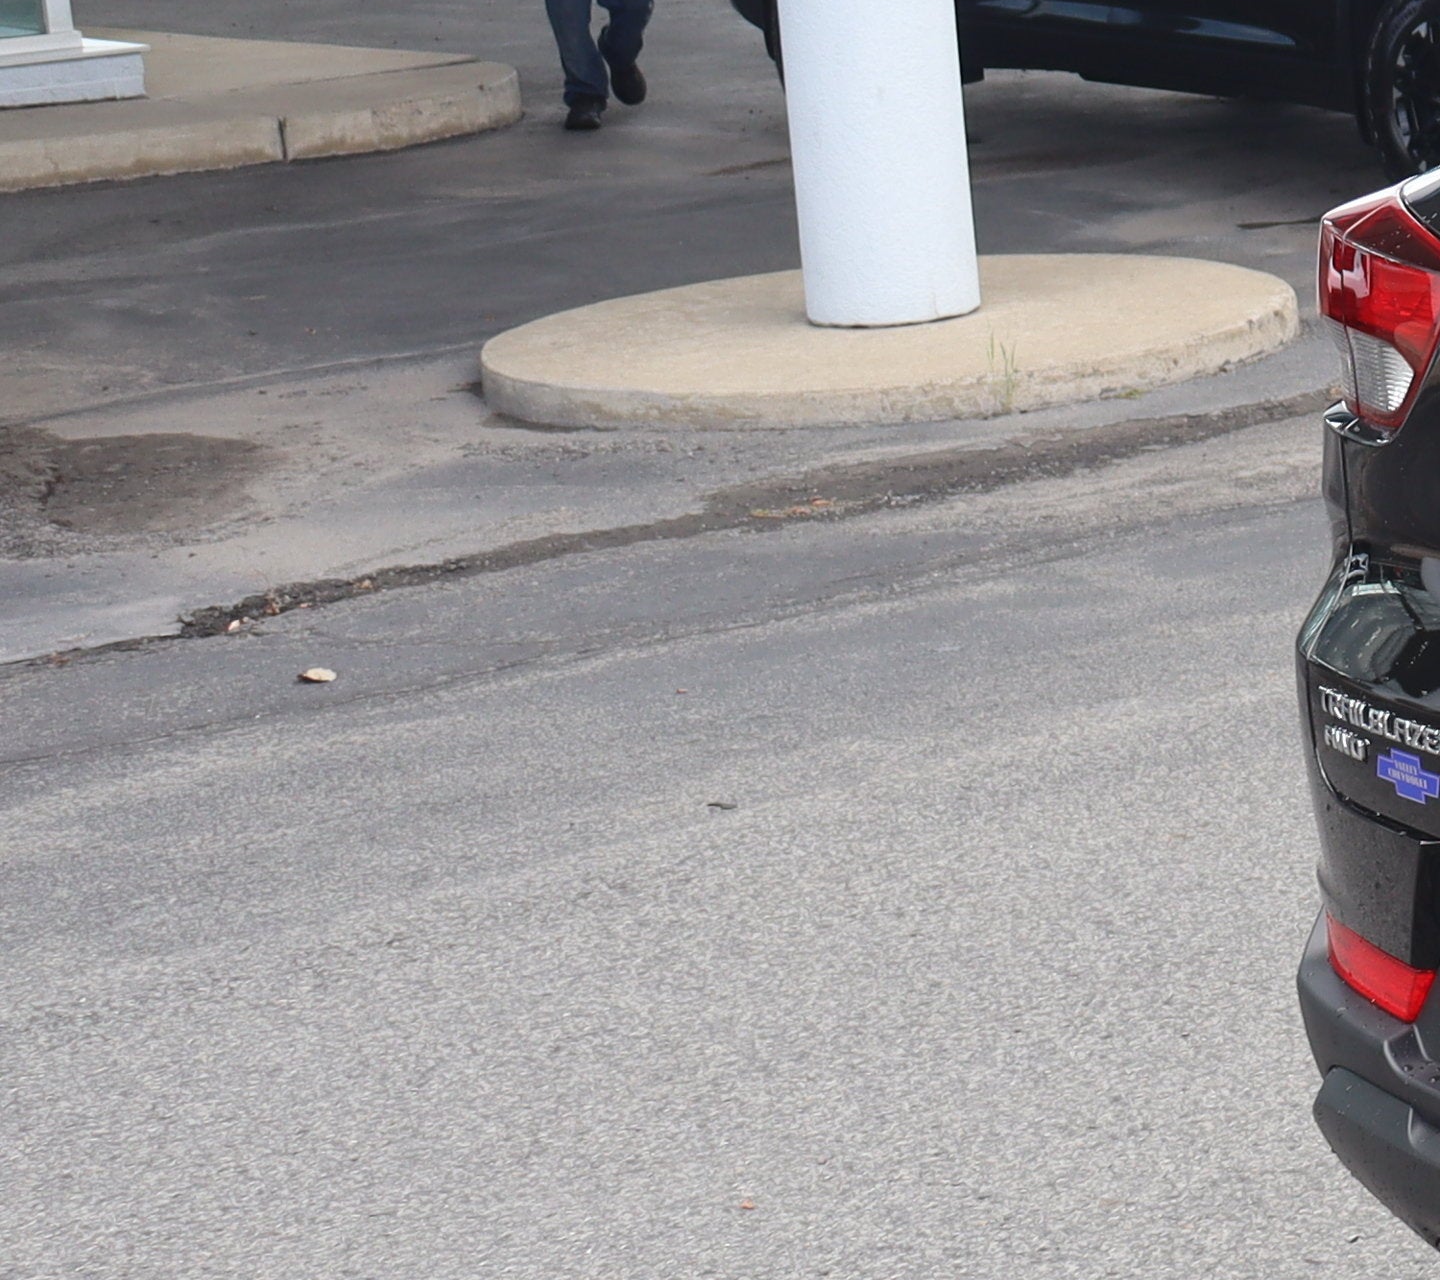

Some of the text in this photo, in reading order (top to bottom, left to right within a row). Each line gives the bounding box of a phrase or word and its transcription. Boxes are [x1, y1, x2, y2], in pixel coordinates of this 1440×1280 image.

[1324, 724, 1370, 761] AWD
[1394, 759, 1419, 775] VALLEY
[1387, 768, 1428, 789] CHEVROLET
